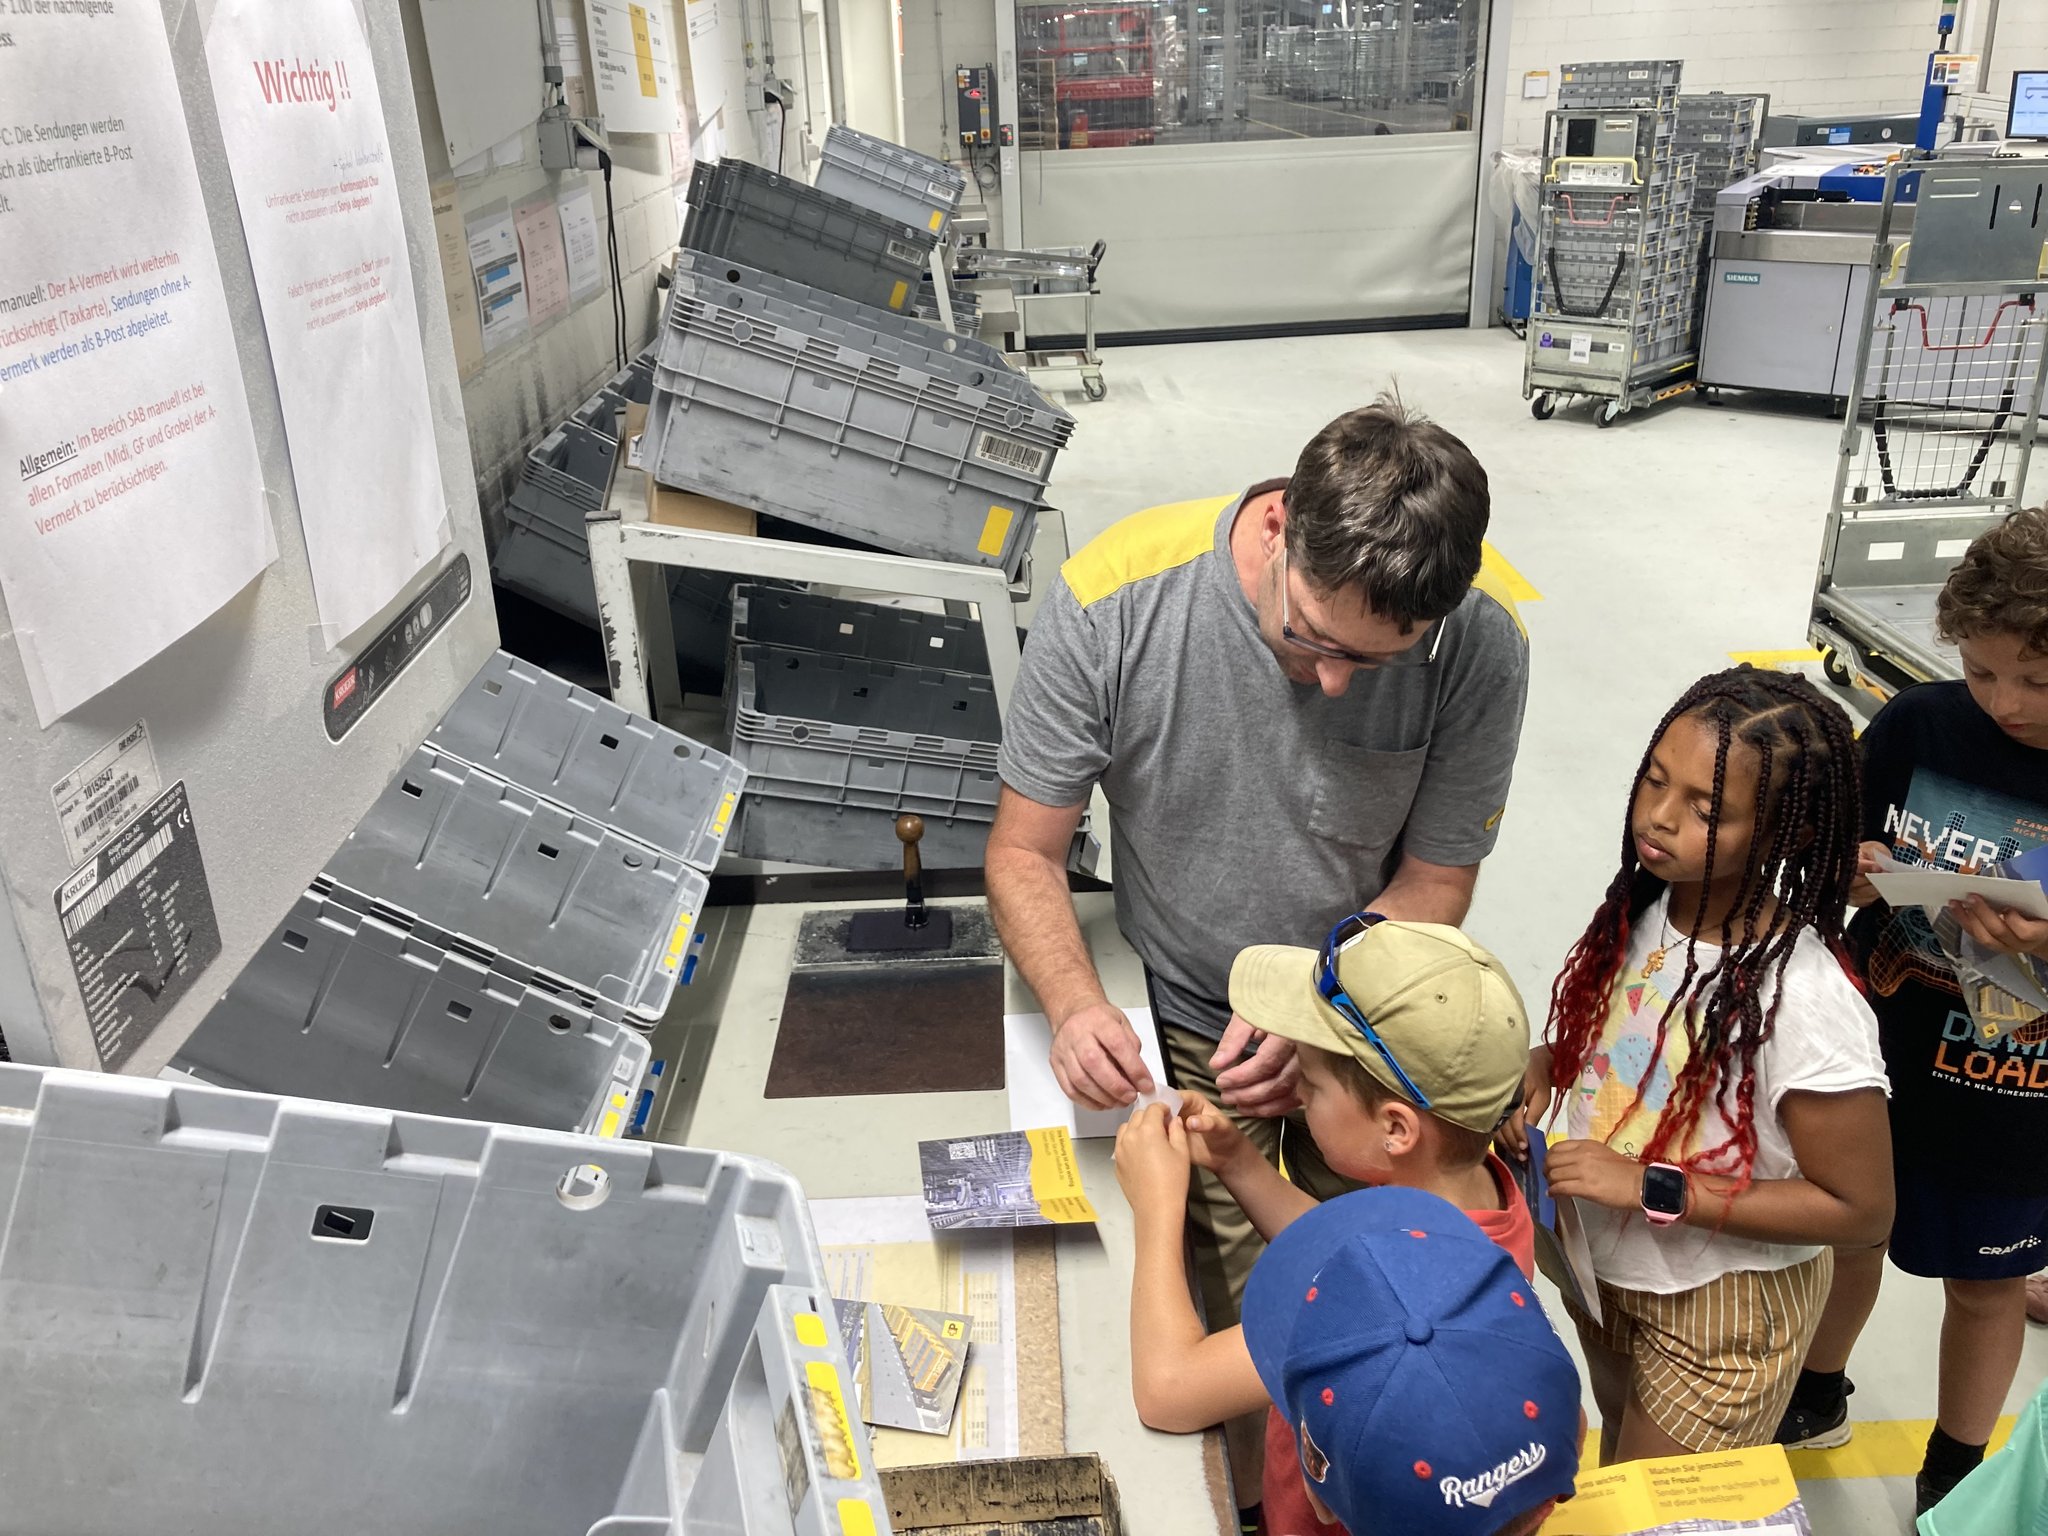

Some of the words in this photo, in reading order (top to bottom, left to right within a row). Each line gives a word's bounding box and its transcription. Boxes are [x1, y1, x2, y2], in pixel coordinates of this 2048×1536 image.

[253, 58, 336, 112] Wichtig
[335, 61, 351, 99] !!
[15, 126, 32, 144] Die
[34, 120, 89, 141] Sendungen
[90, 115, 124, 134] werden
[18, 156, 32, 176] als
[34, 149, 103, 174] überfrankierte
[104, 145, 133, 163] B-Post
[0, 287, 47, 313] manuell:
[48, 279, 66, 300] Der
[69, 264, 119, 295] A-Vermerk
[120, 258, 140, 280] wird
[140, 251, 180, 272] weiterhin
[59, 297, 112, 331] (Taxkarte),
[111, 287, 160, 313] Sendungen
[160, 279, 182, 297] ohne
[183, 274, 192, 292] A-
[1727, 274, 1759, 283] SIEMENS
[40, 342, 79, 367] werden
[81, 335, 95, 353] als
[95, 327, 126, 348] B-Post
[127, 311, 172, 337] abgeleitet.
[19, 440, 78, 479] Allgemein:
[76, 433, 91, 450] Im
[91, 414, 128, 444] Bereich
[128, 406, 146, 428] SAB
[146, 391, 181, 419] manuell
[181, 386, 192, 402] ist
[193, 381, 205, 398] bei
[27, 483, 55, 507] allen
[55, 461, 104, 493] Formaten
[104, 443, 133, 472] (Midi,
[133, 436, 146, 455] GF
[147, 428, 164, 449] und
[164, 414, 194, 440] Grobe)
[193, 408, 207, 426] der
[208, 404, 217, 418] A-
[35, 502, 83, 536] Vermerk
[84, 496, 95, 512] zu
[95, 458, 168, 505] berücksichtigen.
[83, 767, 113, 800] 10152547
[1884, 804, 2001, 869] NEVER
[1932, 1070, 1961, 1084] ENTER
[1974, 1083, 1994, 1092] NEW
[1979, 1239, 2027, 1255] CRAFT
[1439, 1442, 1546, 1508] Rangers
[1671, 1475, 1700, 1484] Freude
[1682, 1464, 1695, 1472] Sie
[1697, 1460, 1744, 1472] jemandem
